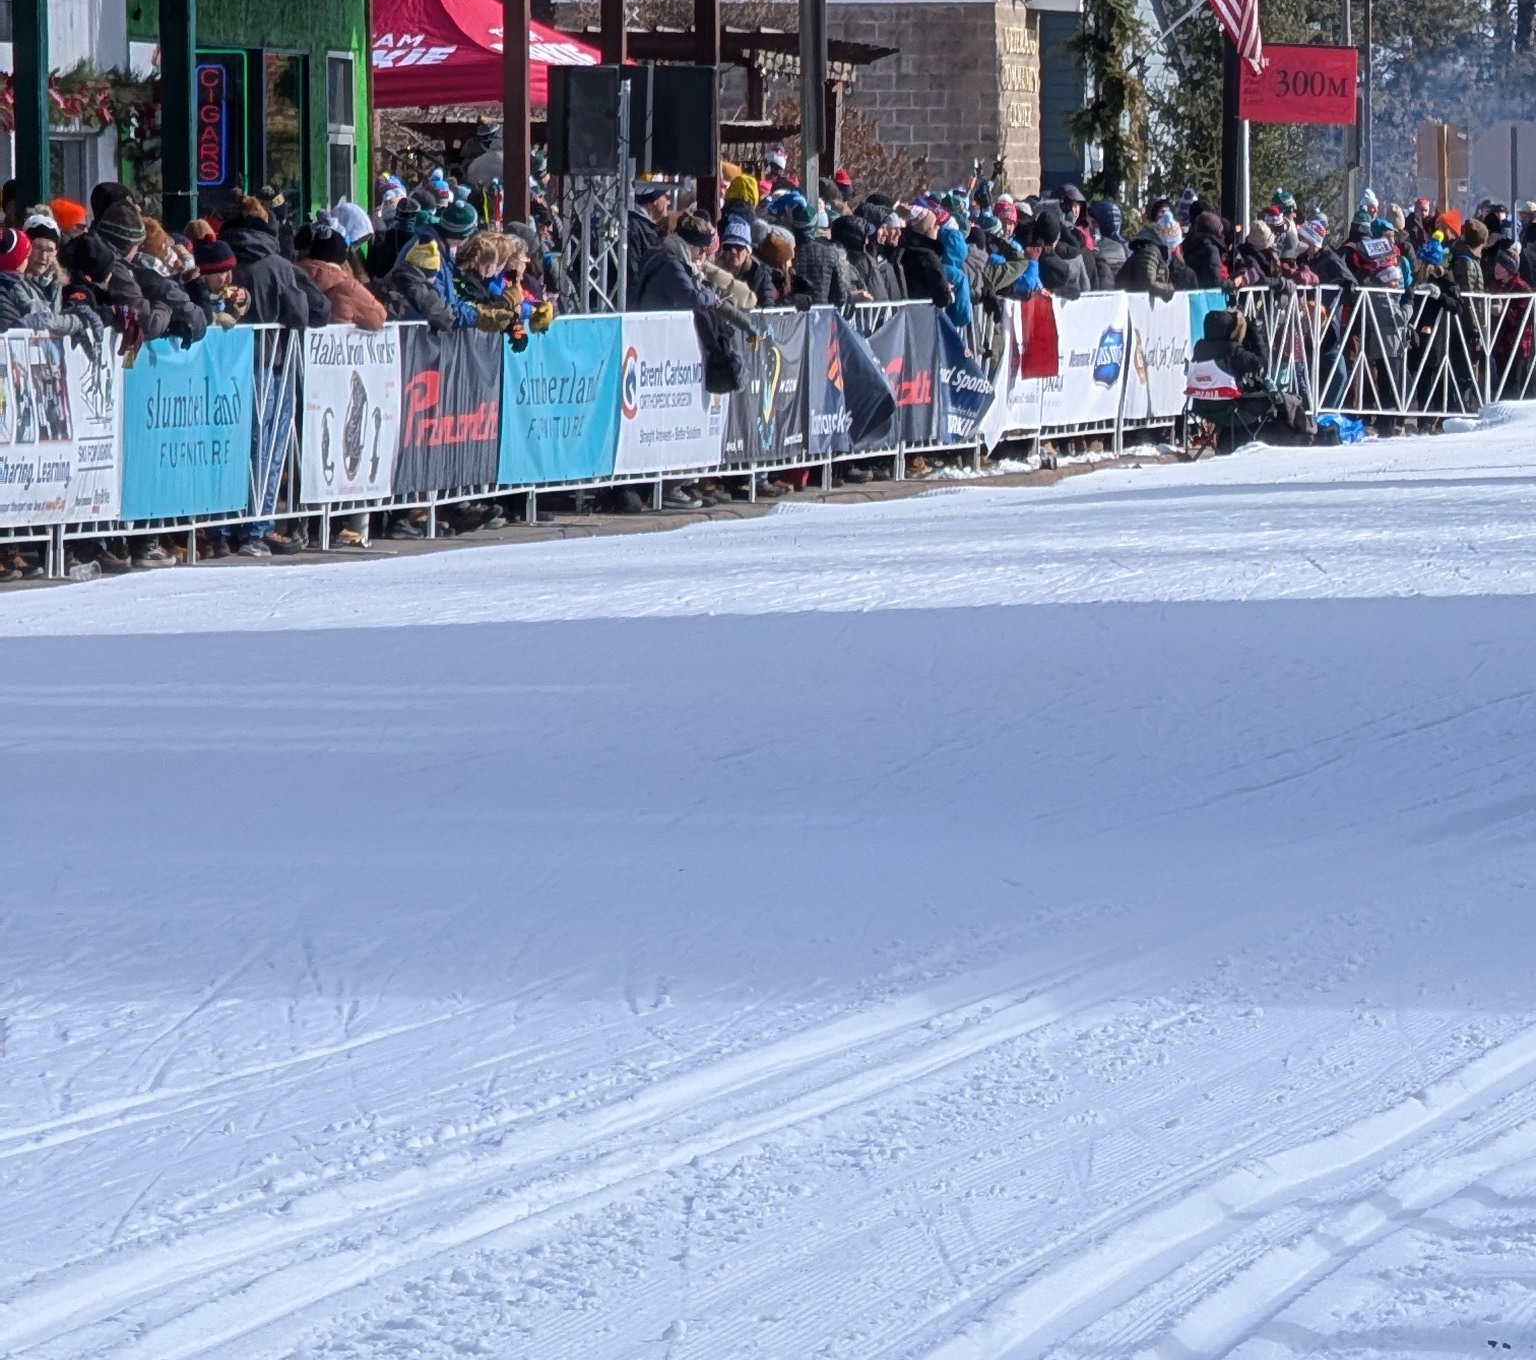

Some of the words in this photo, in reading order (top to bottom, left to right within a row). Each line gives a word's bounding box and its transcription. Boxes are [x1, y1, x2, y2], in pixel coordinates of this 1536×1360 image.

[1275, 70, 1349, 98] 300M
[200, 68, 221, 181] CIGARS
[640, 360, 663, 387] Brent
[36, 453, 72, 489] Learning.
